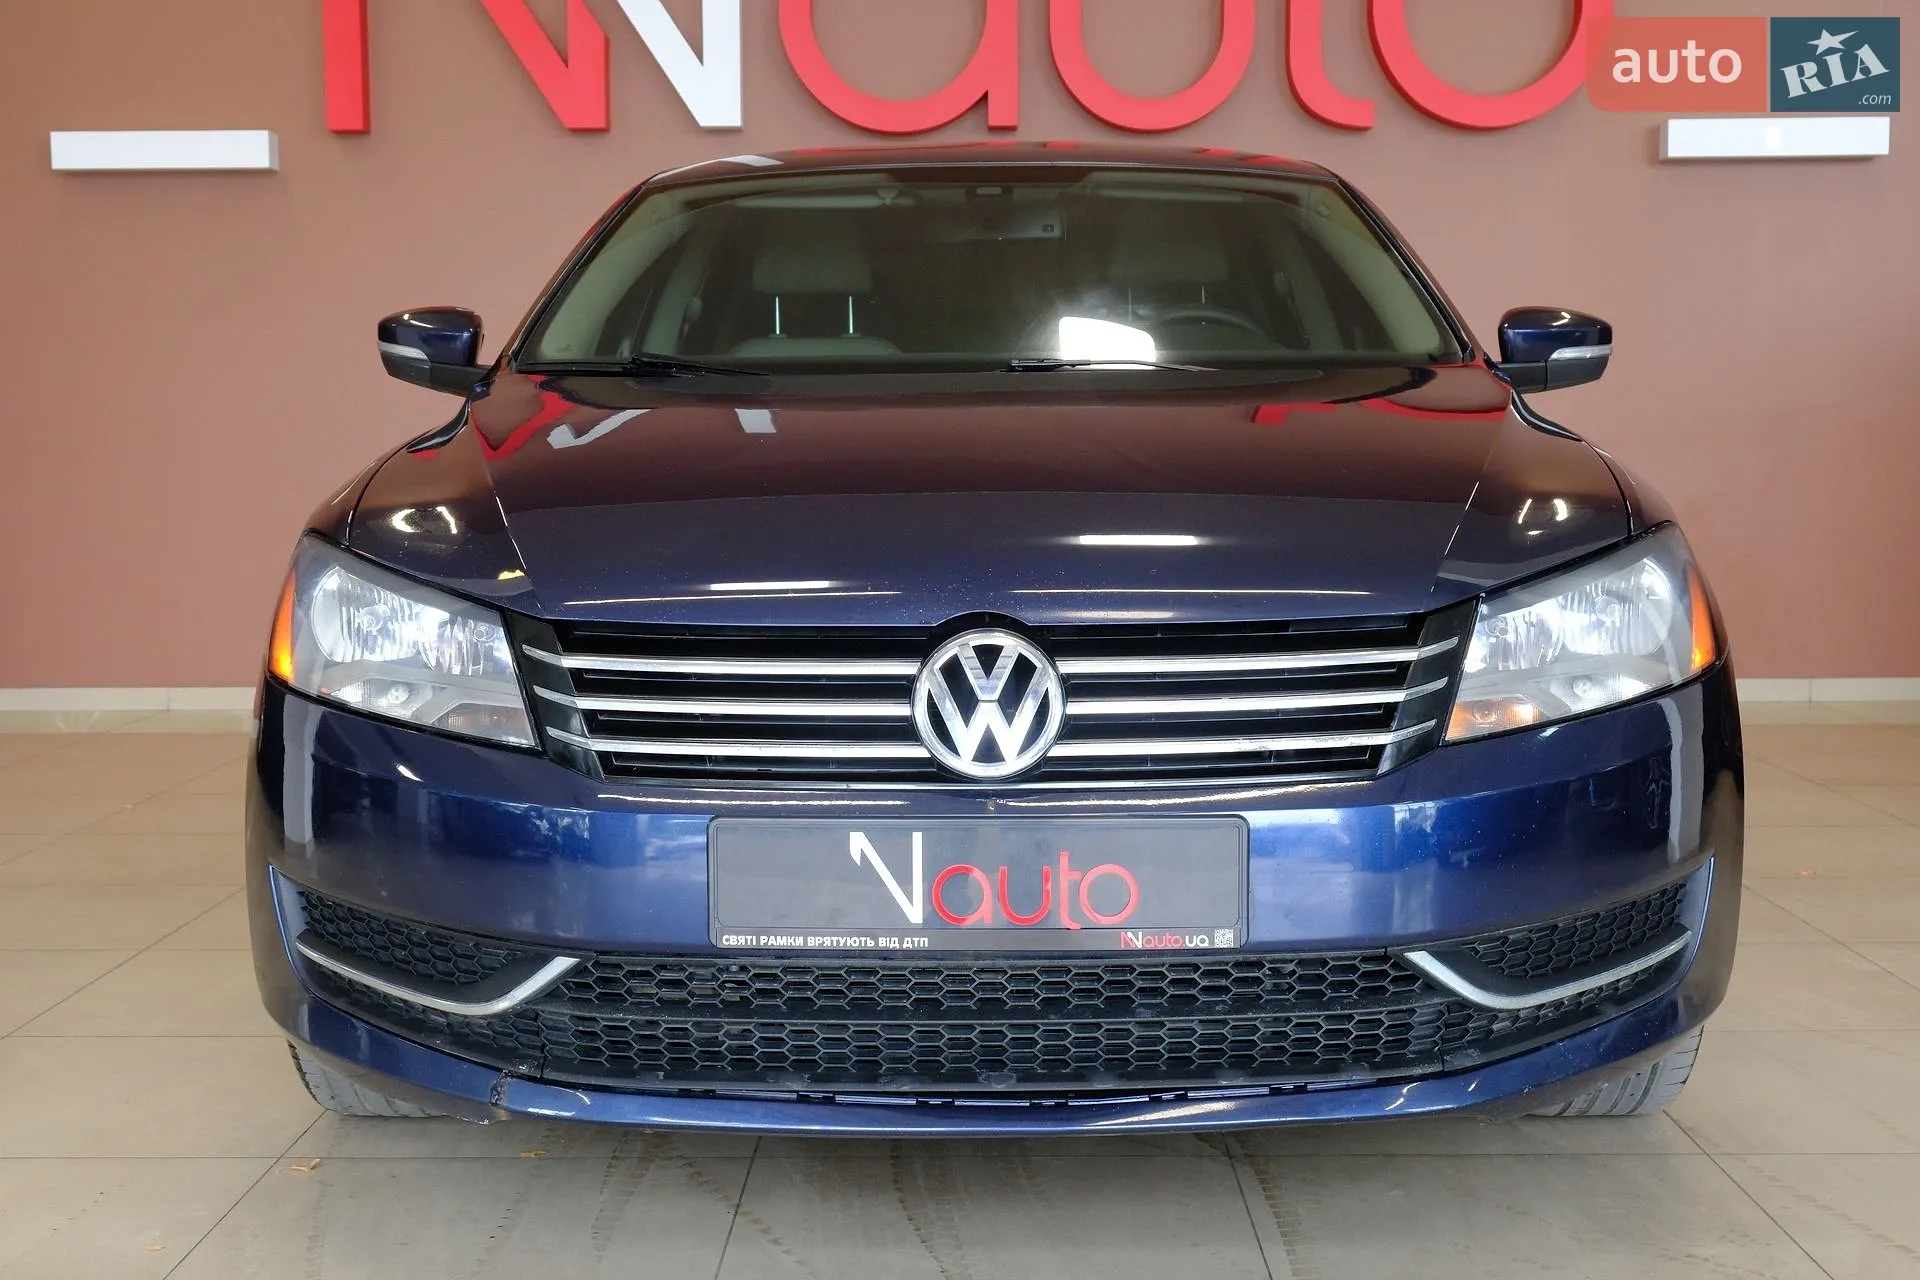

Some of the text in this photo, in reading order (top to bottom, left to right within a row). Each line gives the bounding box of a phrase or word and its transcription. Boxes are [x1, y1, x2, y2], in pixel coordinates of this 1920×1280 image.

[920, 636, 1060, 775] VW
[850, 832, 1140, 931] Nauto
[722, 935, 929, 949] СВЯТІ РАМКИ ВРЯТУЮТЬ ВІД ДТП
